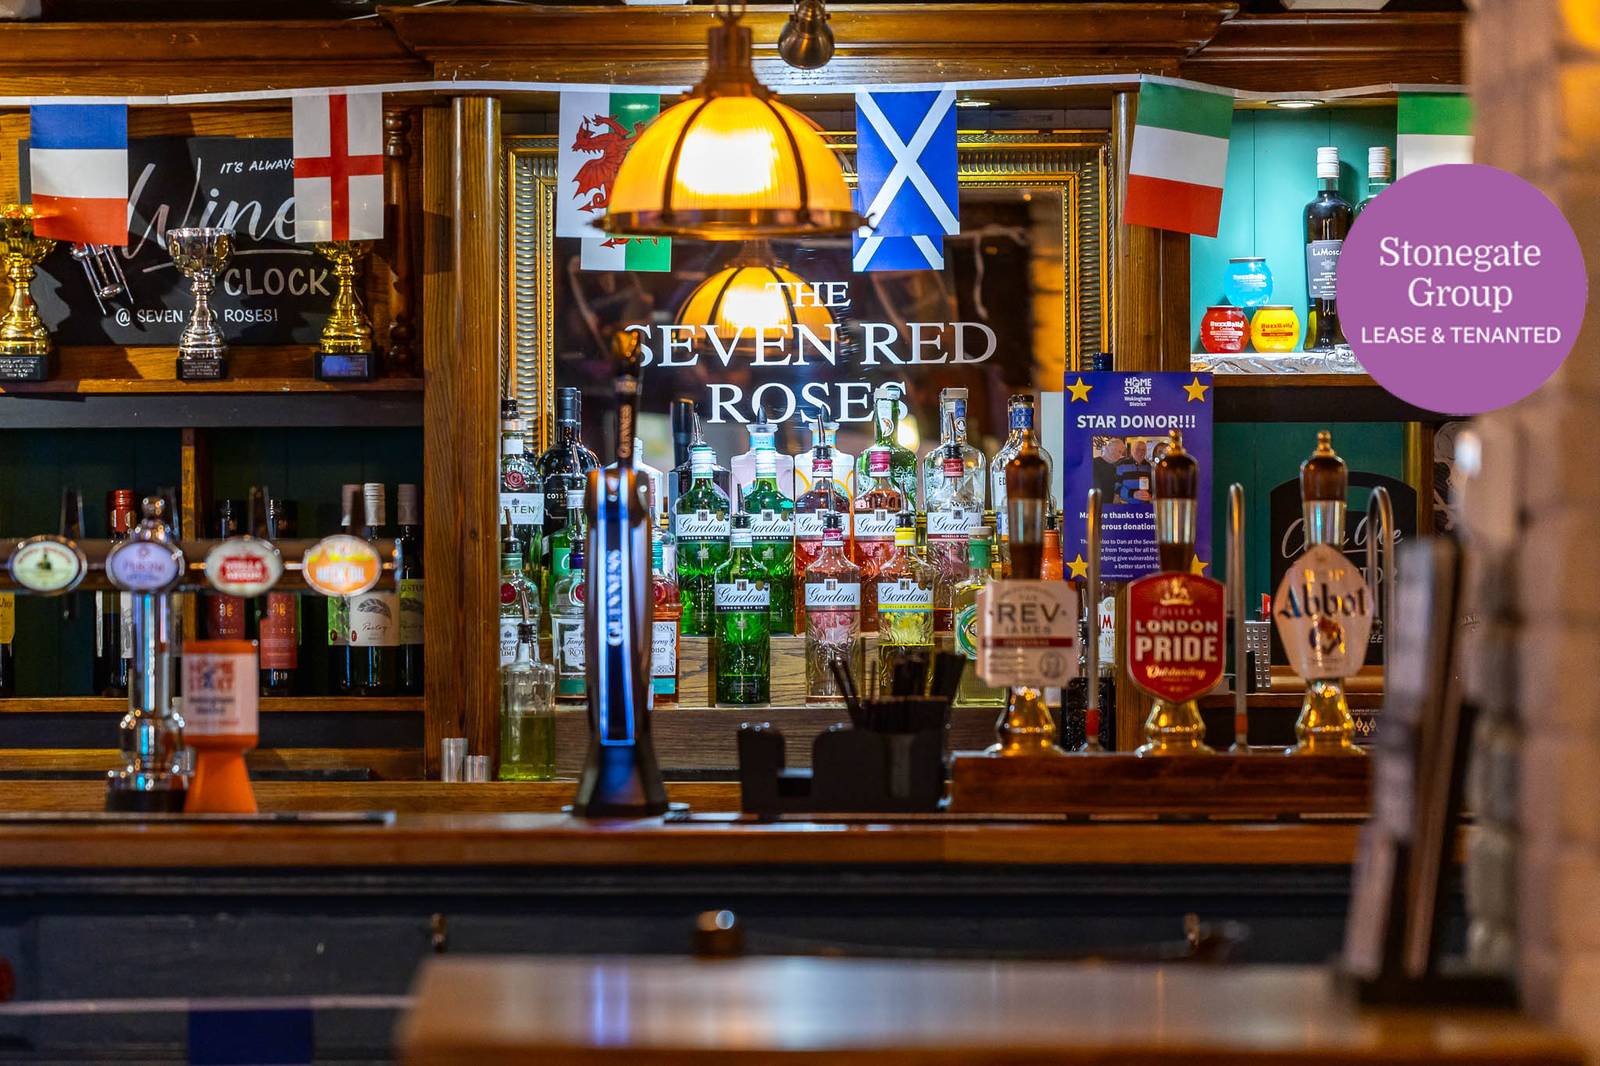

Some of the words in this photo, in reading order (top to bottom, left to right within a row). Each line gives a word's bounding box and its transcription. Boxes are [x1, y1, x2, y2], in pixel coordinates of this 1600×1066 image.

[224, 268, 330, 296] CLOCK
[765, 281, 850, 307] THE
[137, 308, 184, 323] SEVEN
[624, 322, 843, 367] SEVEN
[859, 322, 998, 365] RED
[1124, 387, 1152, 395] START
[1076, 415, 1117, 429] STAR
[1120, 415, 1197, 429] DONOR!!!
[511, 505, 536, 514] TEN
[1109, 511, 1135, 519] thanks
[680, 518, 726, 534] Gordon's
[717, 587, 767, 604] Gordon's
[807, 587, 856, 604] Gordon's
[881, 586, 929, 603] Gordon's
[997, 603, 1060, 624] REV
[1135, 620, 1219, 634] LONDON
[1134, 635, 1219, 662] PRIDE
